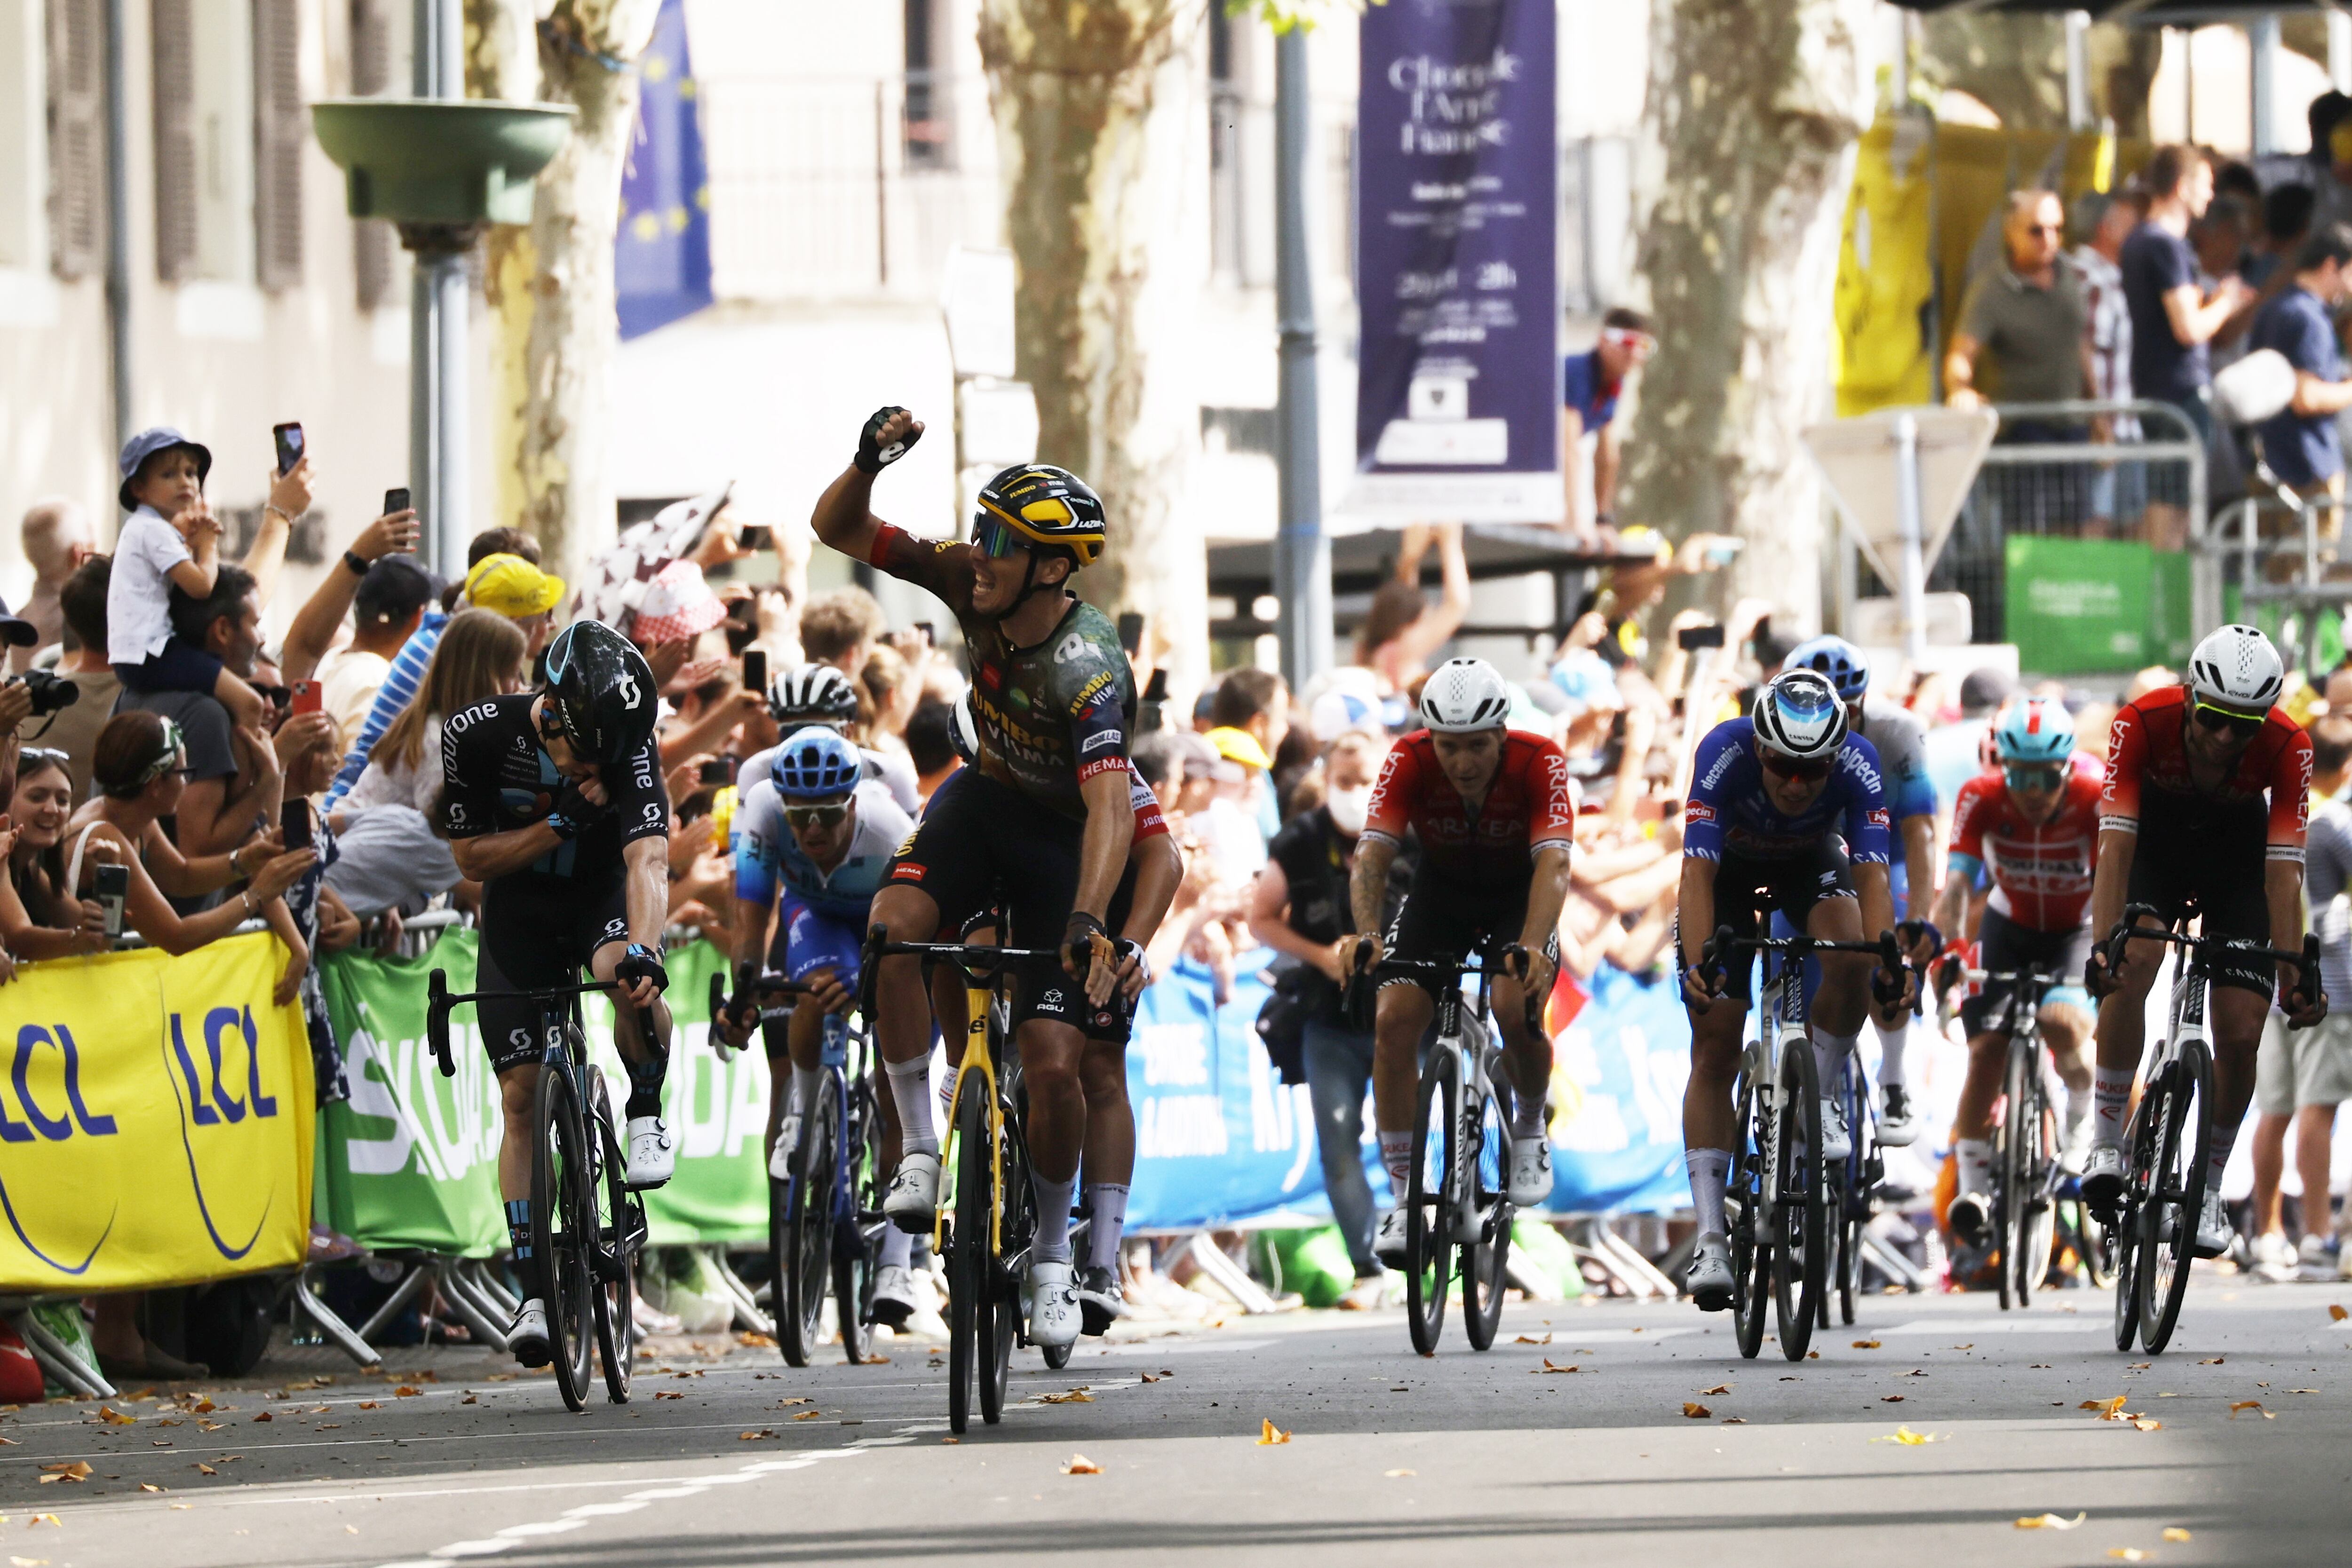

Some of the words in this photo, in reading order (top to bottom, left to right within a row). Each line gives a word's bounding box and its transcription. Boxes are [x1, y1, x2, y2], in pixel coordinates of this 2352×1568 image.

[1009, 485, 1037, 499] JUMBO
[1078, 520, 1101, 528] LAZER
[560, 698, 580, 738] SCOTT
[1069, 670, 1113, 718] JUMBO
[447, 702, 499, 788] youfone
[1789, 733, 1815, 742] CANYON
[2102, 720, 2131, 802] ARKEA
[1082, 757, 1127, 780] HEMA
[1367, 751, 1405, 819] ARKEA
[1544, 754, 1569, 829] ARKEA
[1837, 745, 1882, 795] Alpecin
[2296, 748, 2313, 832] ARKEA
[1036, 1003, 1065, 1012] AGU
[170, 1003, 277, 1126] LCL
